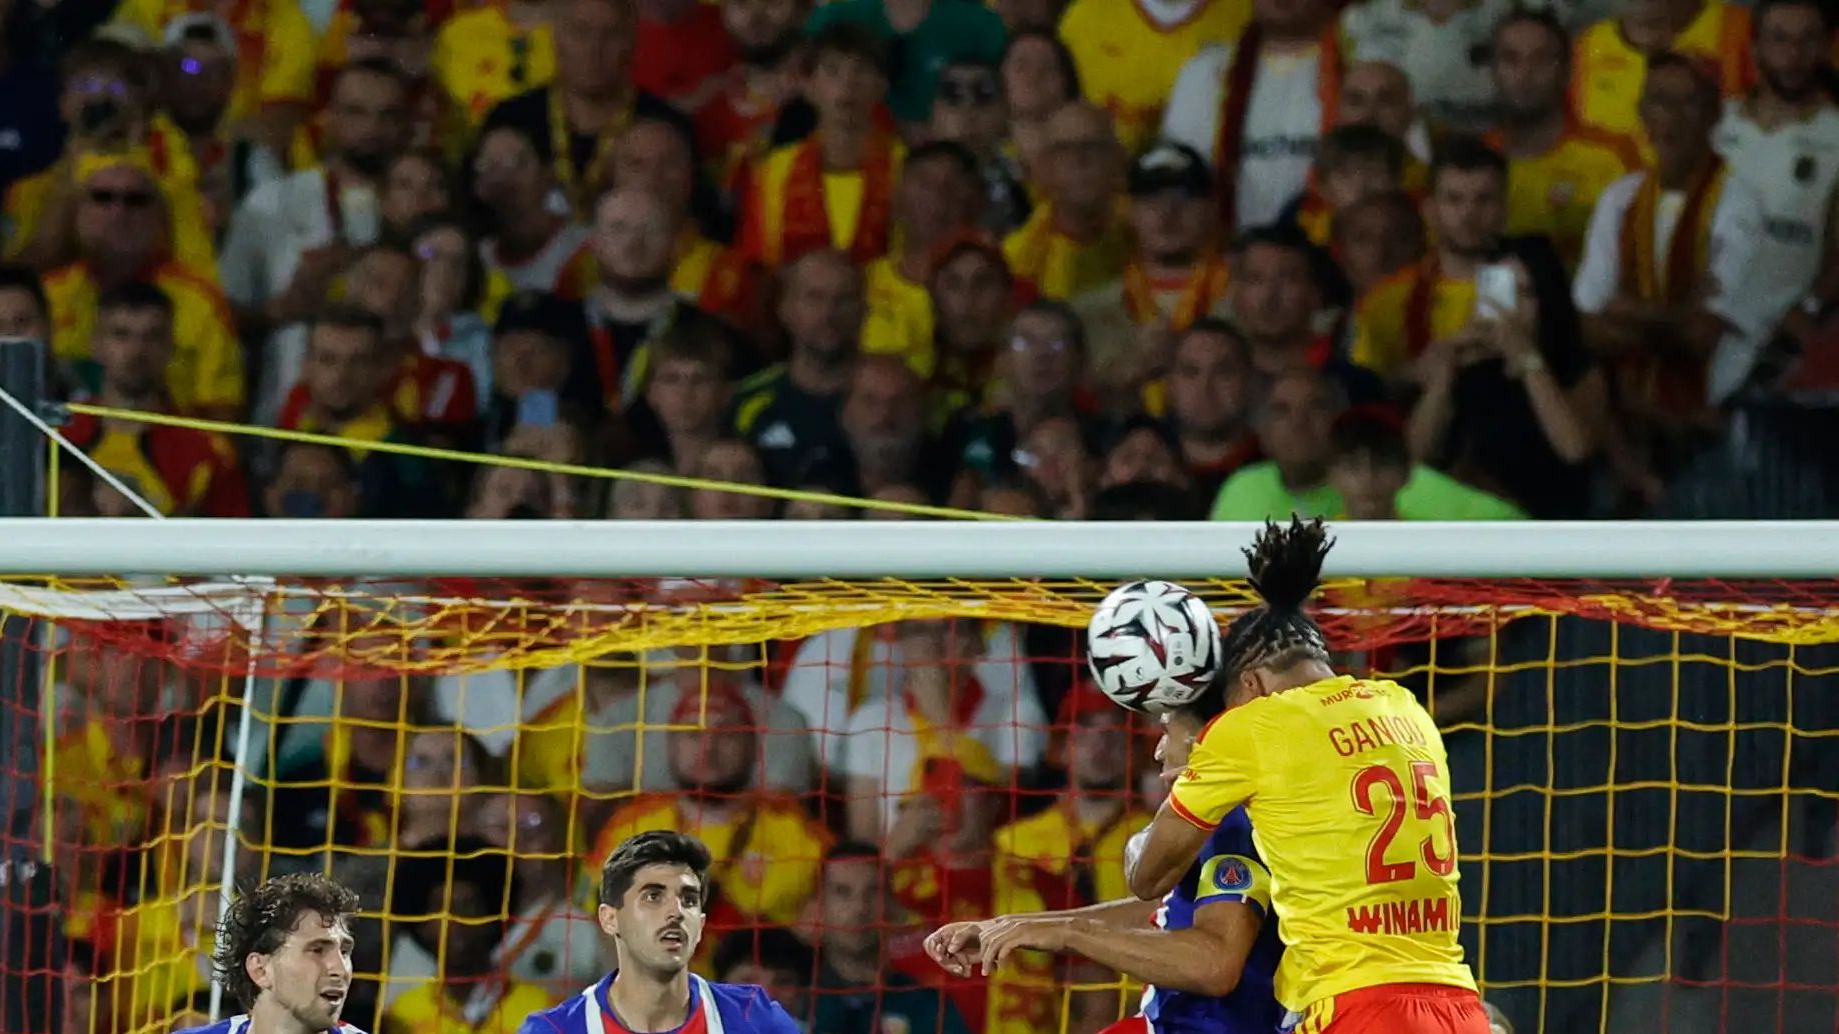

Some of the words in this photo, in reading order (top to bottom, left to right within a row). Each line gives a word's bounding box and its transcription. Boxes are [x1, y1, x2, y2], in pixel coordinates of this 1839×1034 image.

[1328, 715, 1426, 757] GANIOU
[1351, 760, 1456, 884] 25
[1347, 898, 1459, 935] WINAM
